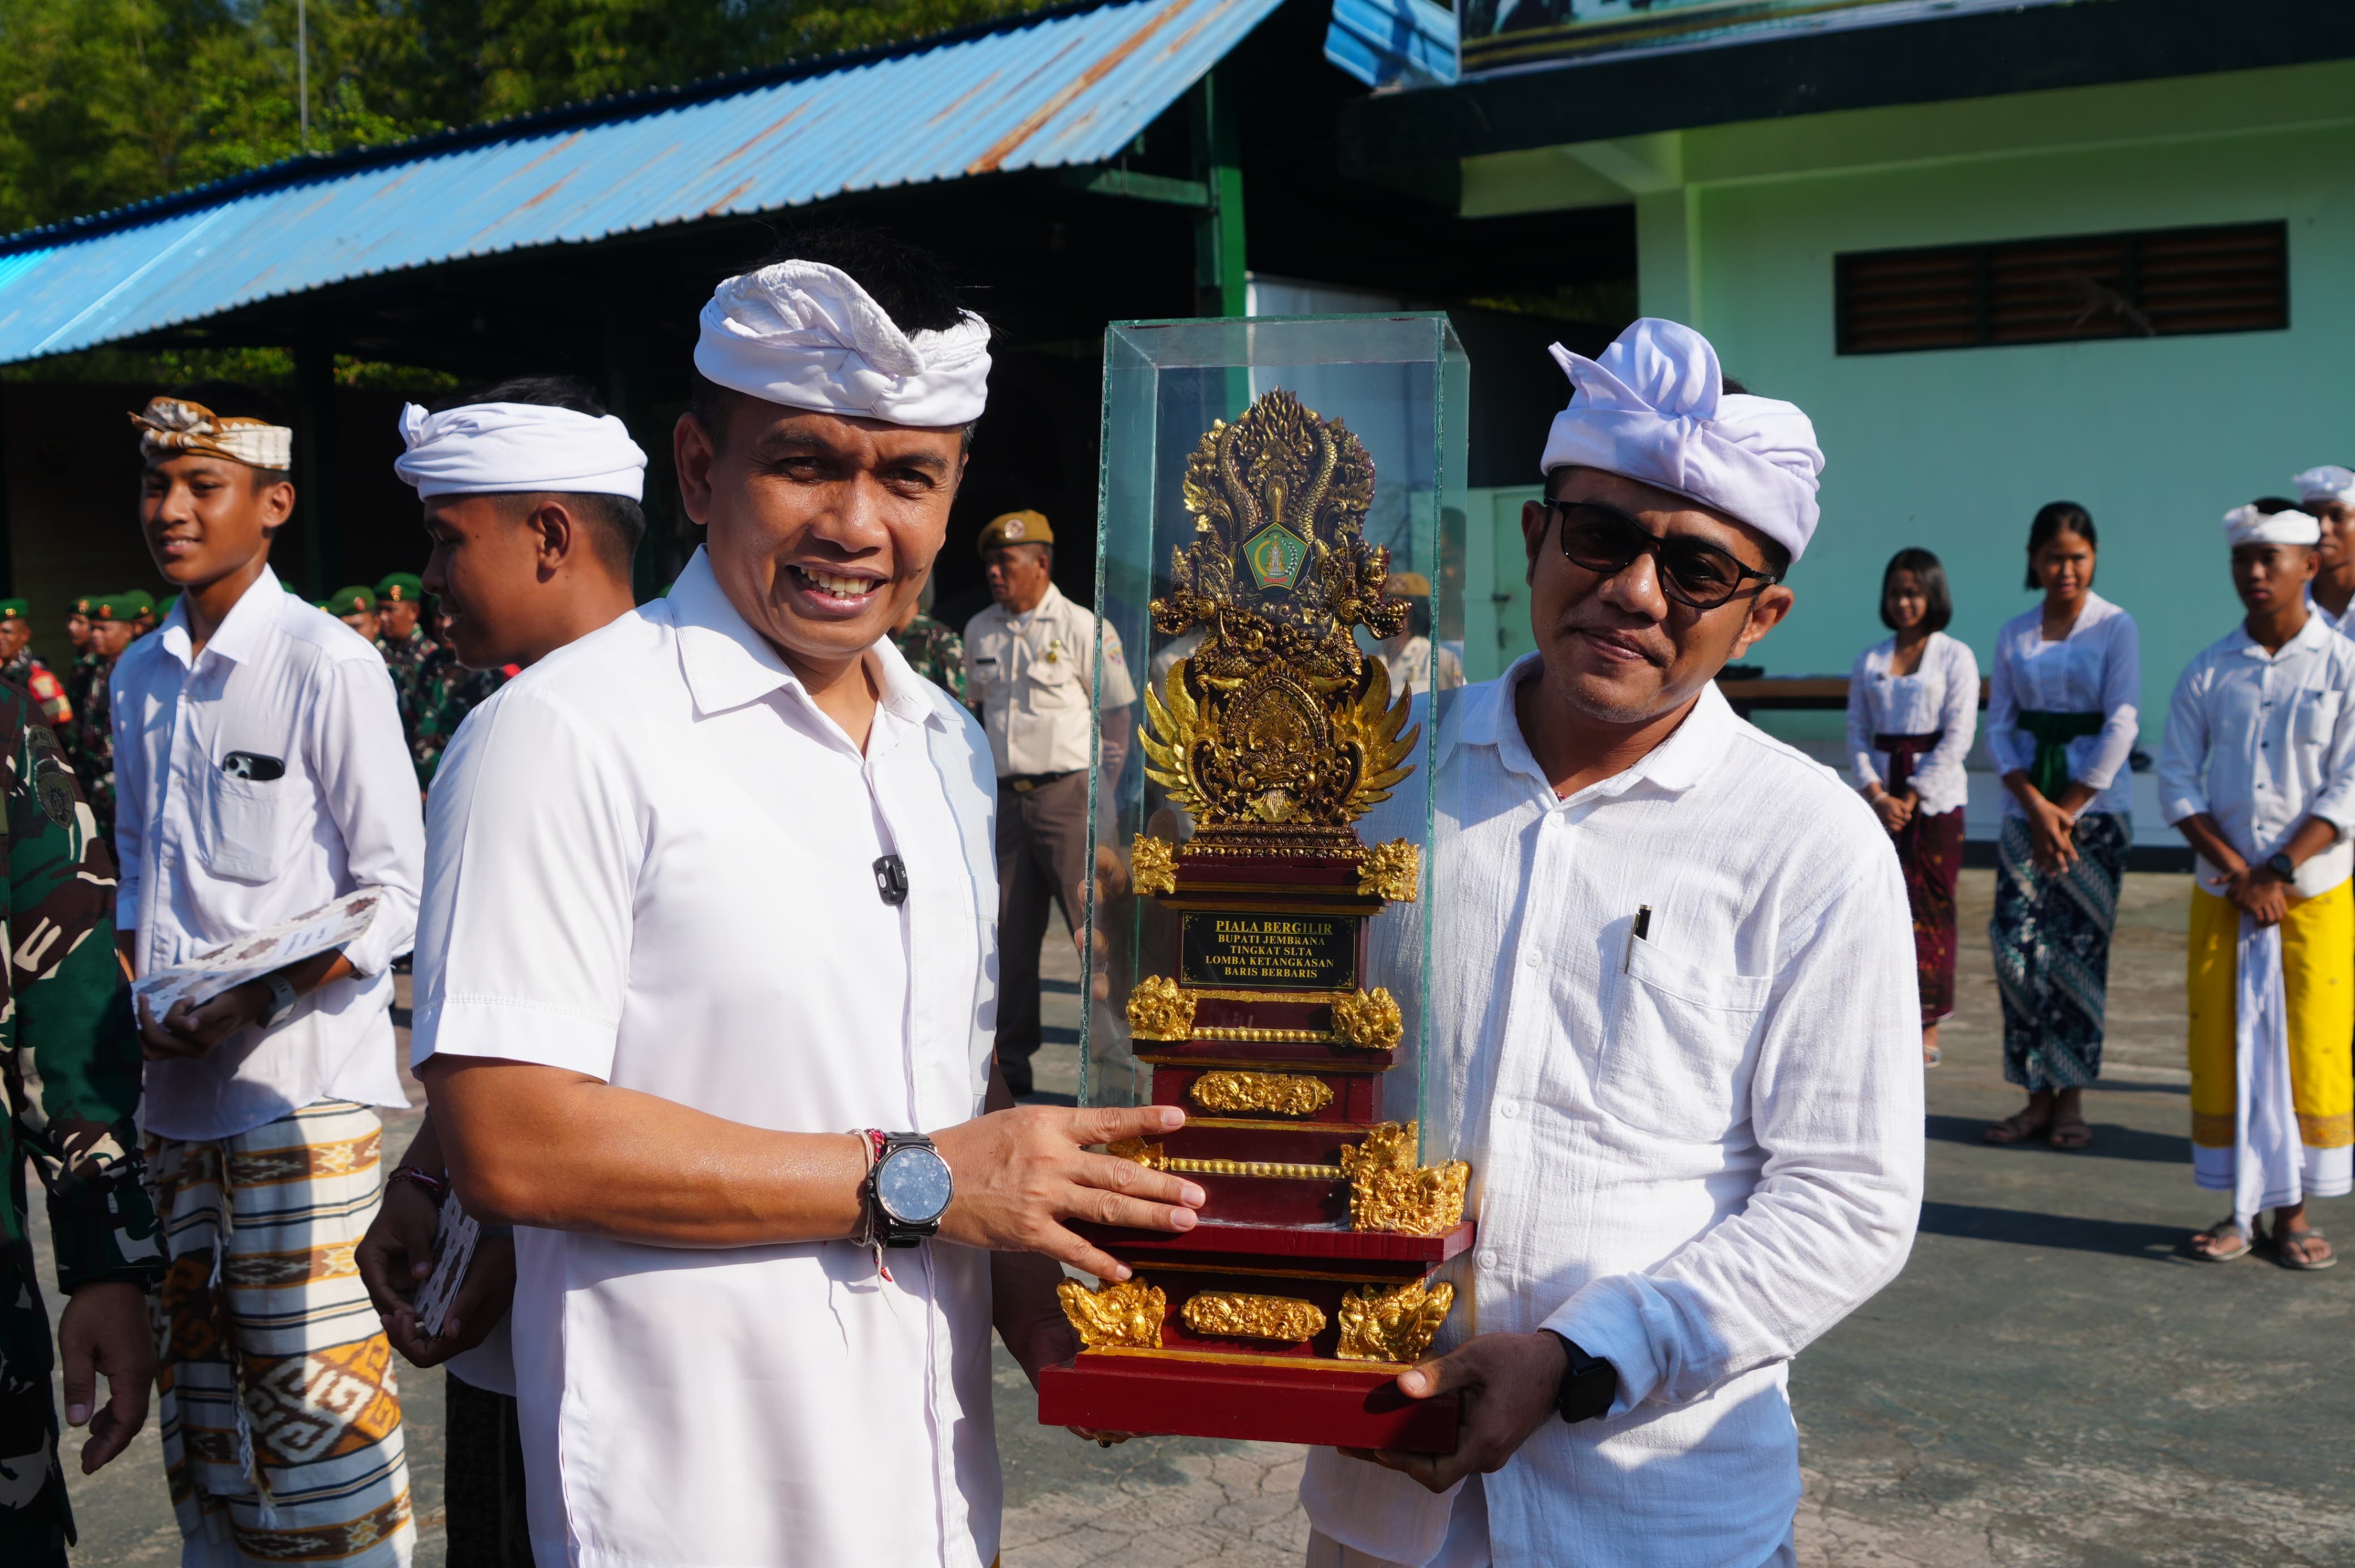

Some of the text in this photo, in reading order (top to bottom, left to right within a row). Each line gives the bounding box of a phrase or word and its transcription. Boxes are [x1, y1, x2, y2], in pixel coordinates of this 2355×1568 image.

[1216, 920, 1331, 933] PIALA BERGILIR
[1218, 935, 1324, 945] BUPATI JEMBRANA
[1230, 945, 1312, 956] TINGKAT SLTA
[1206, 956, 1334, 967] LOMBA KETANGKASAN
[1224, 967, 1317, 978] BARIS BERBARIS
